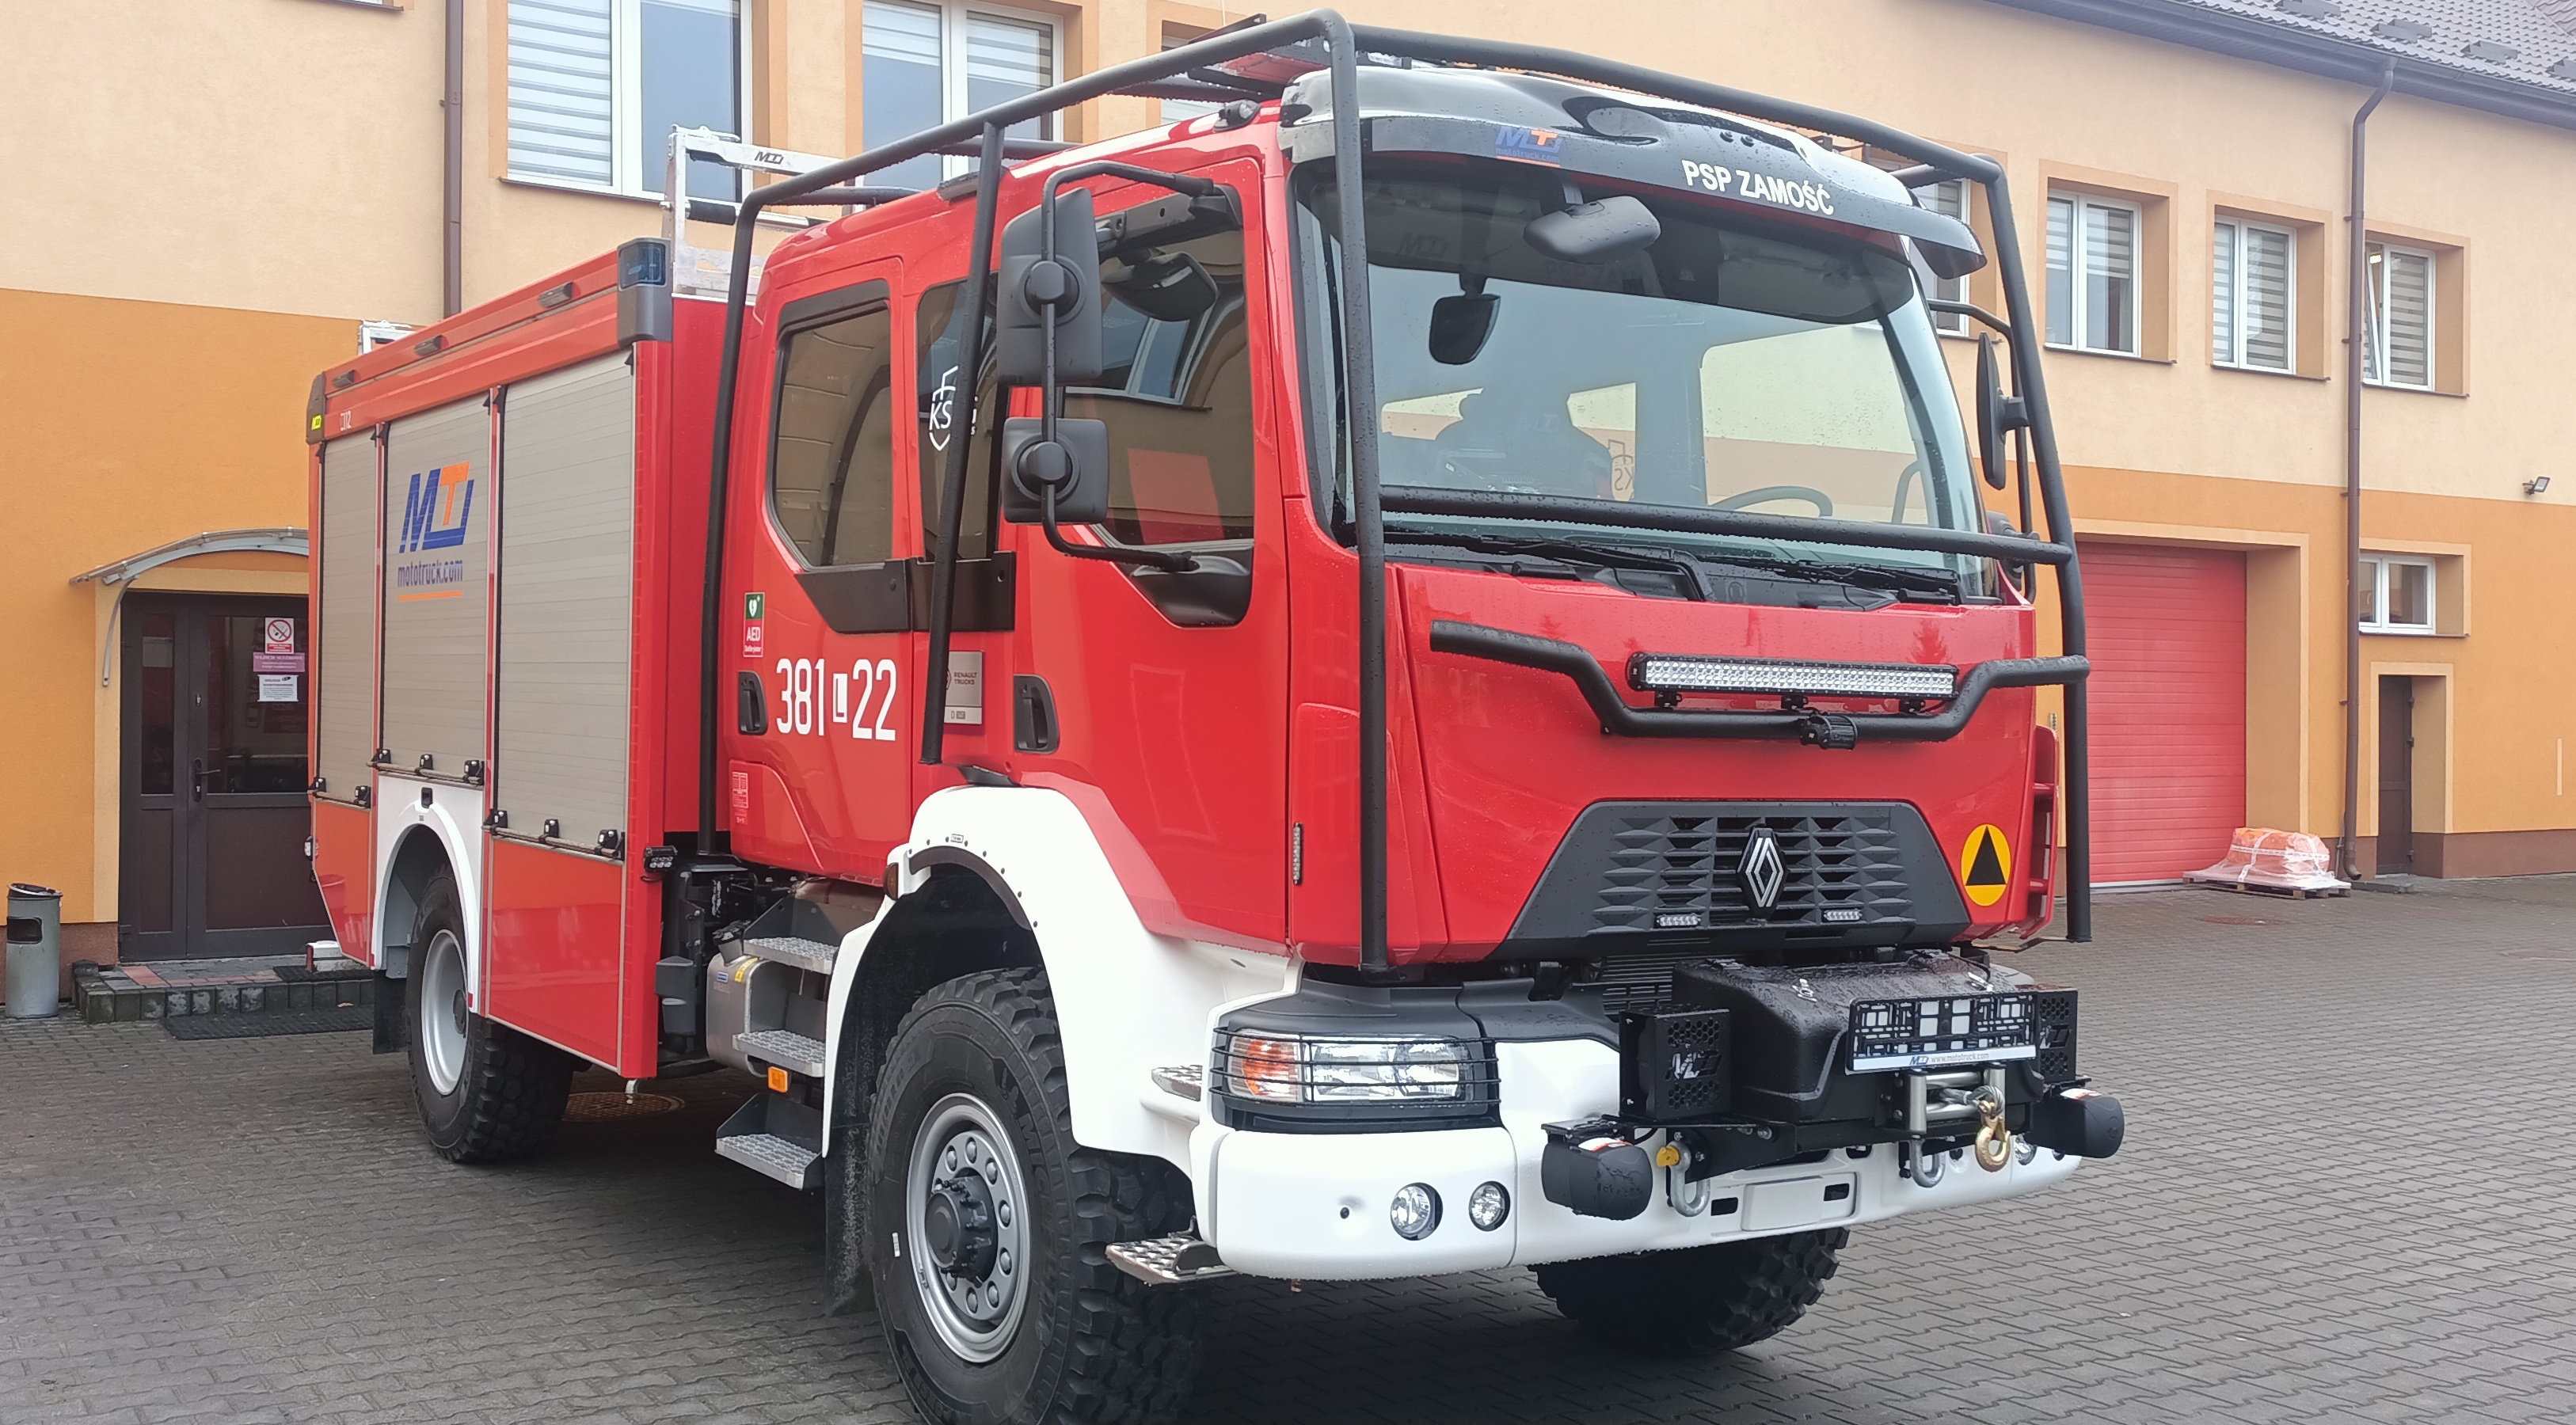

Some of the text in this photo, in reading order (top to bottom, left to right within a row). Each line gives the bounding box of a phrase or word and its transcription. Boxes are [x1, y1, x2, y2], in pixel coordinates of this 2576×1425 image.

[1495, 147, 1560, 163] mototruck.com
[1682, 159, 1835, 215] PSP ZAMOŚĆ
[398, 559, 463, 588] mototruck.com
[746, 626, 761, 642] AED
[776, 658, 825, 736] 381
[852, 659, 897, 741] 22
[1931, 1053, 1989, 1063] www.mototruck.com
